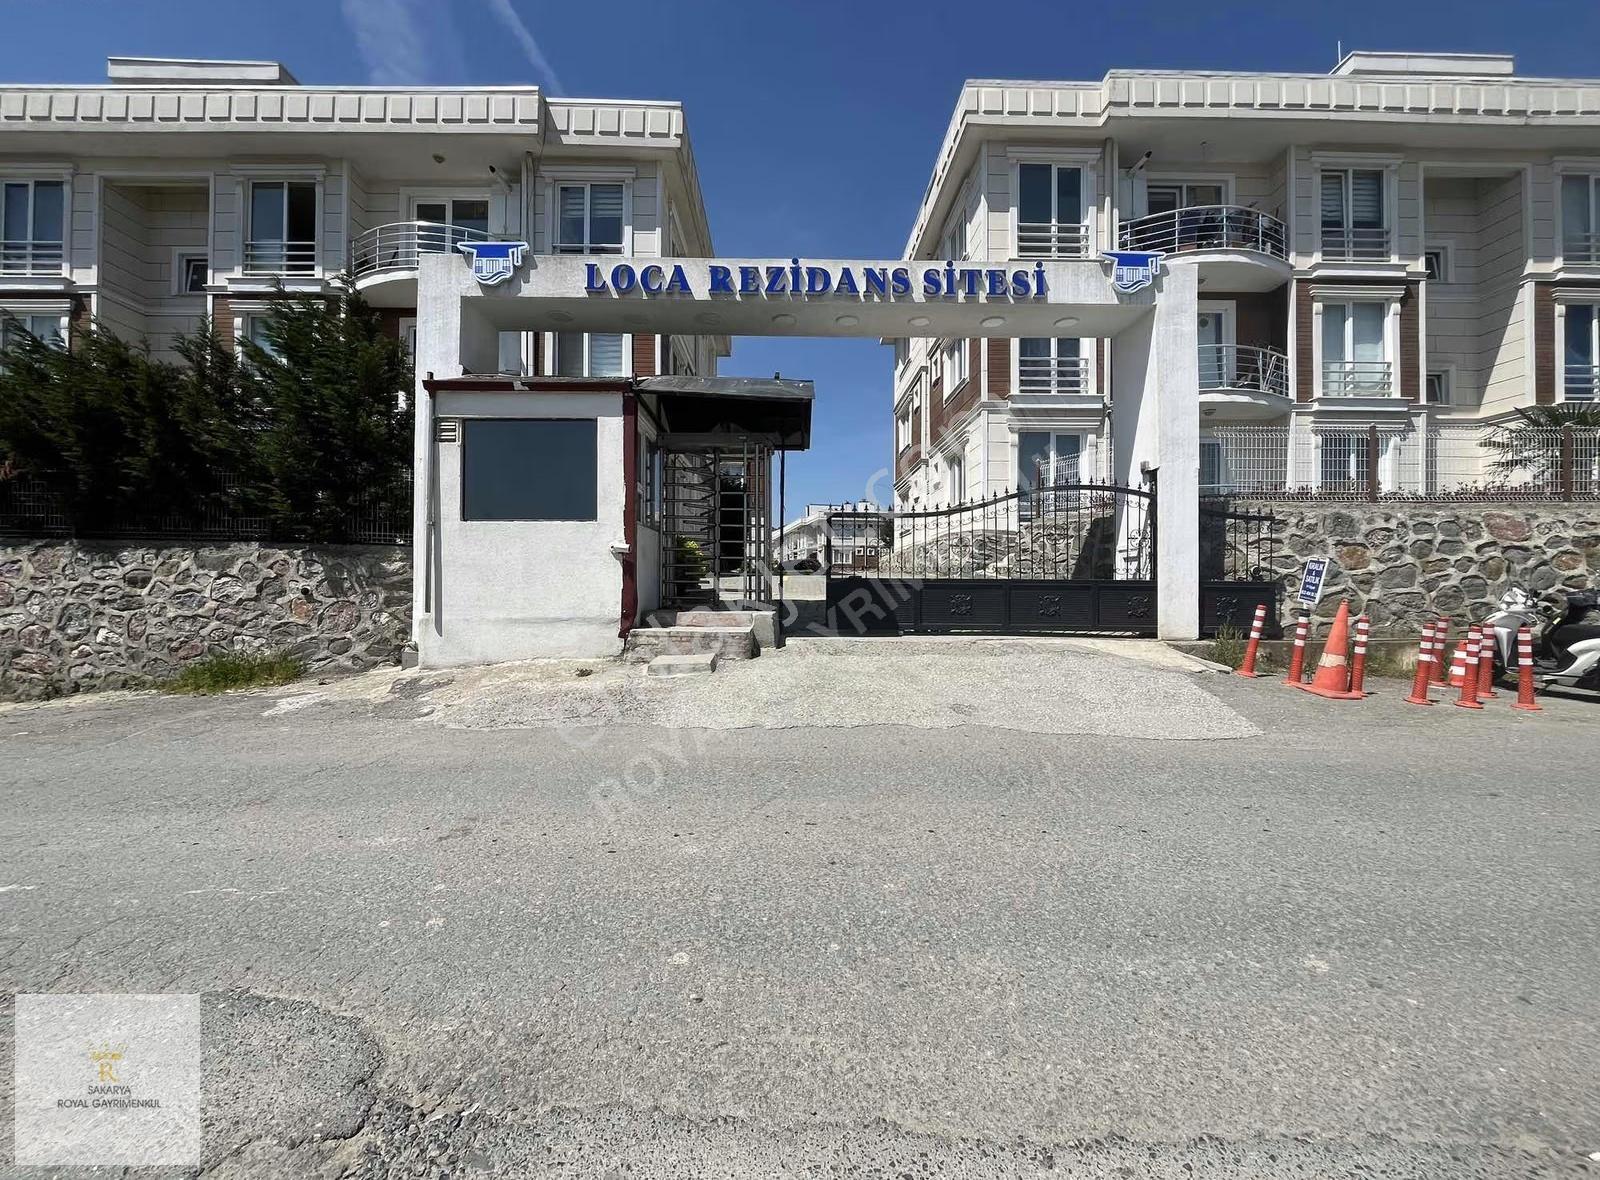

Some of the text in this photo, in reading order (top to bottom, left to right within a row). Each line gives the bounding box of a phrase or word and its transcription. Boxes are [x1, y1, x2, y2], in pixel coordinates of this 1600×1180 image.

[585, 257, 1047, 298] LOCA REZİDANS SİTESİ
